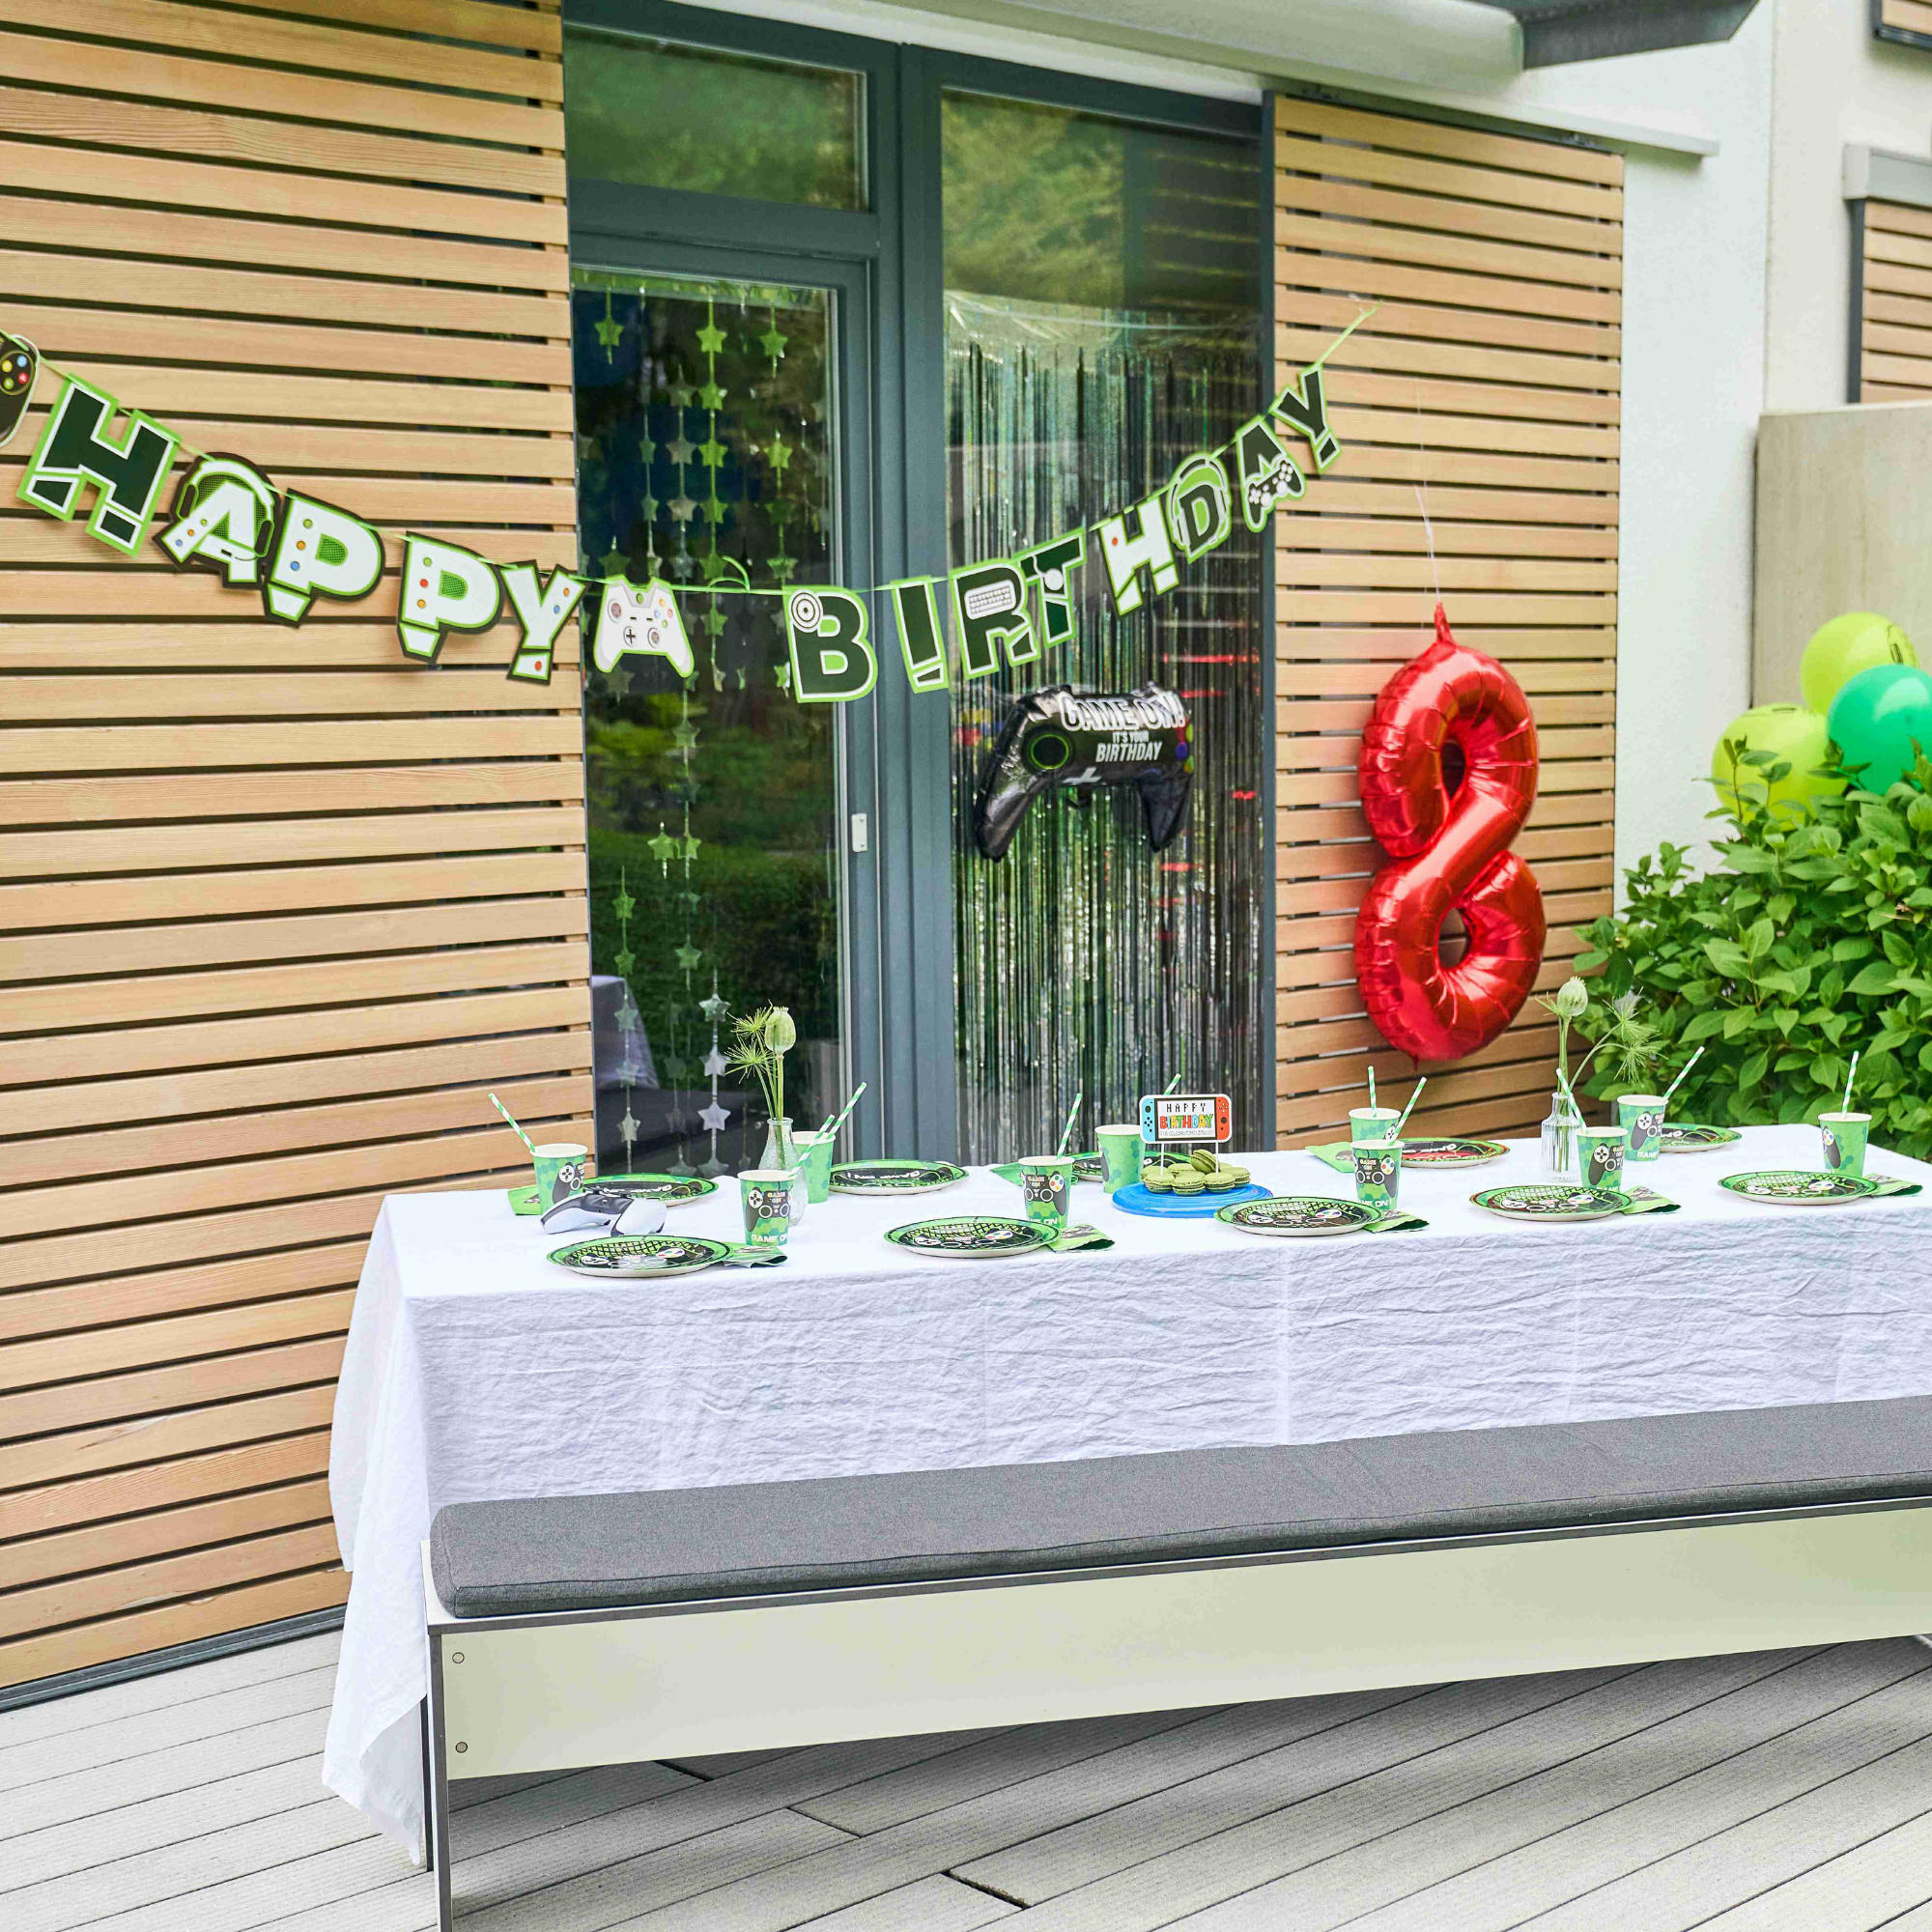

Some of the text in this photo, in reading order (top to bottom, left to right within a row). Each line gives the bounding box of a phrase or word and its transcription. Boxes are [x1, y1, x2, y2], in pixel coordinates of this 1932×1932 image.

[17, 364, 1343, 704] HAPPY BIRTHDAY
[1058, 693, 1141, 731] GAME
[1112, 729, 1150, 744] IT'S YOUR
[1095, 742, 1162, 762] BIRTHDAY
[1167, 1103, 1206, 1112] HAPPY
[1160, 1114, 1213, 1129] BIRTHDAY
